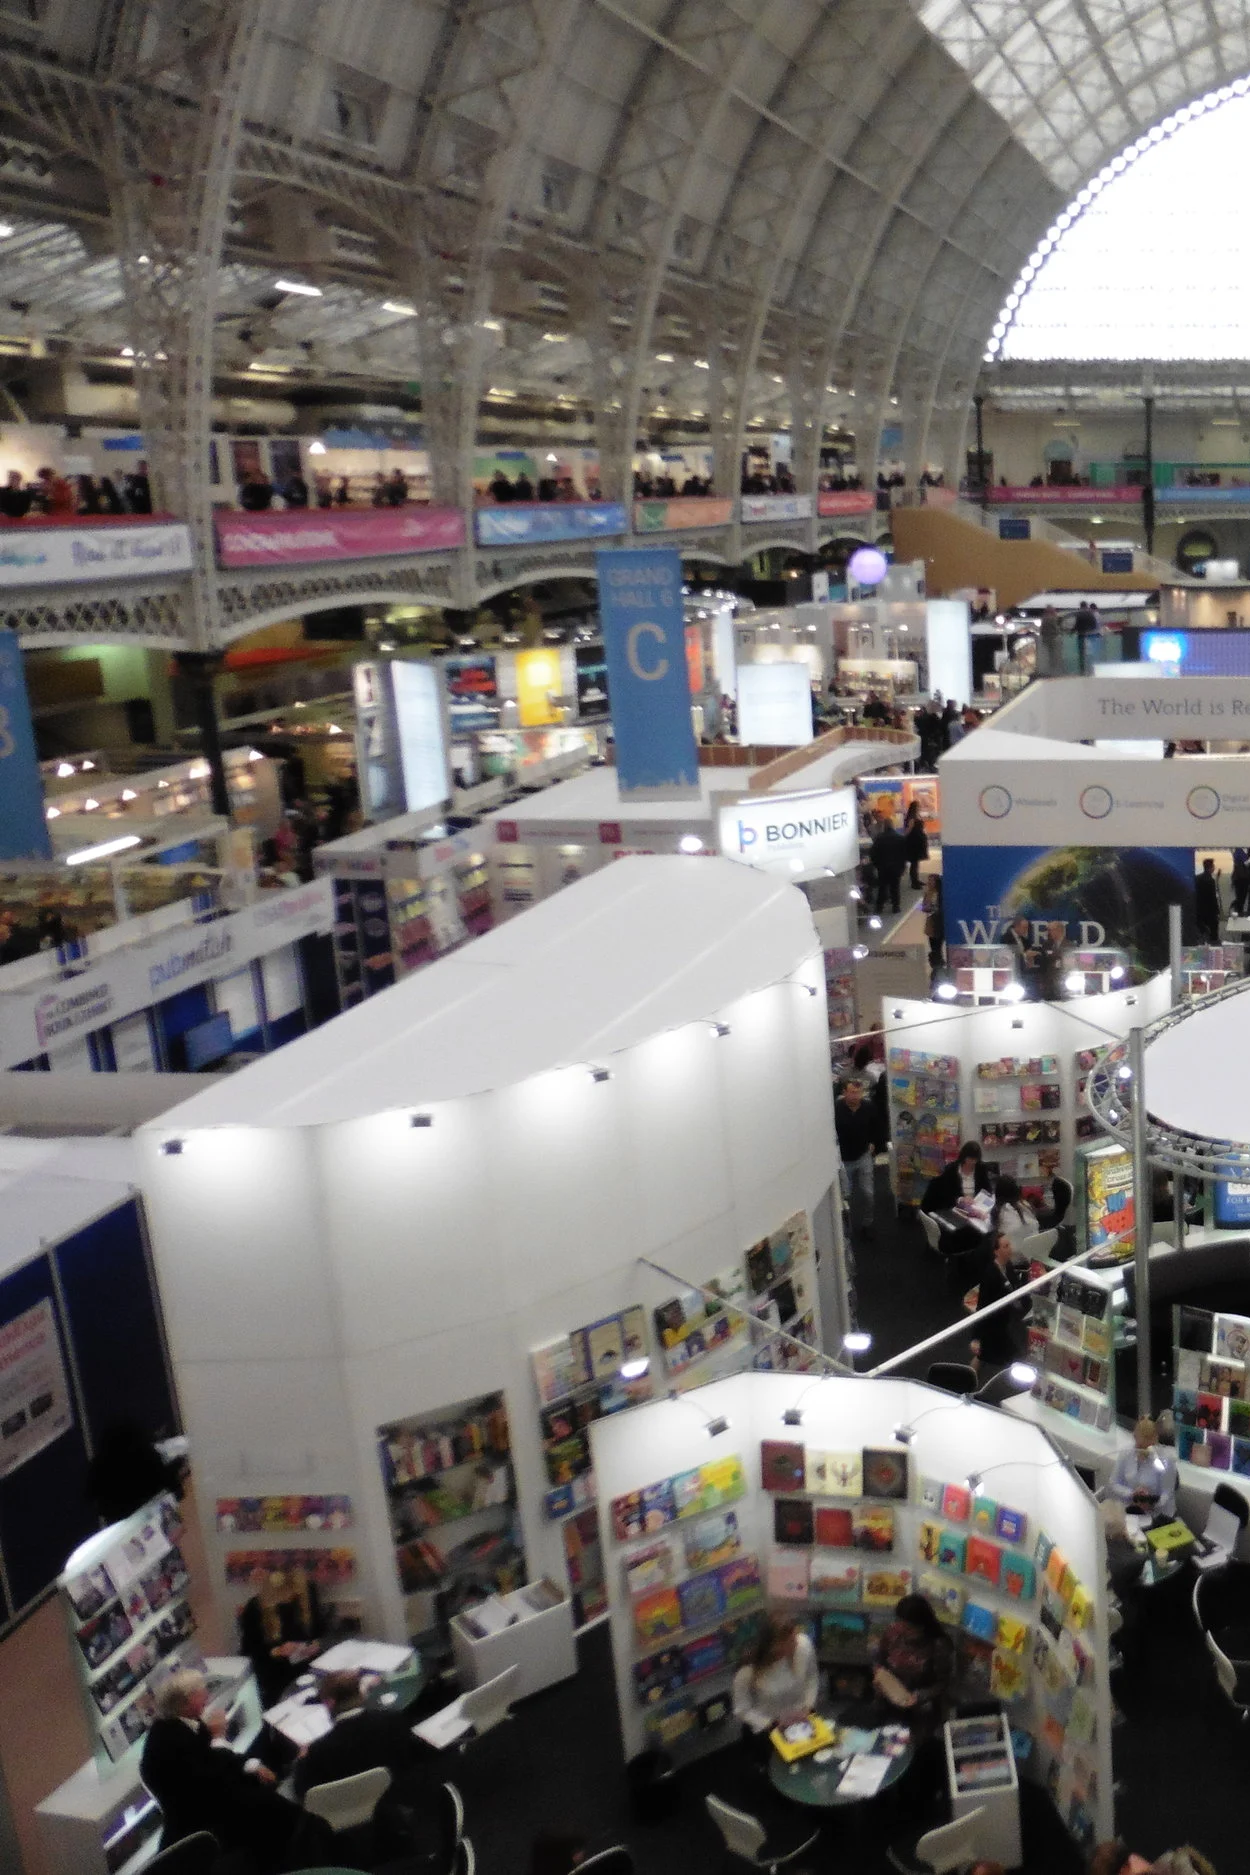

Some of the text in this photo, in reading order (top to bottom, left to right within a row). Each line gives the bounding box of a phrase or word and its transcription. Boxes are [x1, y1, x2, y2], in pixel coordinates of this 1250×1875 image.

[607, 567, 675, 587] GRAND
[611, 589, 657, 608] HALL
[627, 622, 669, 681] C
[1100, 699, 1135, 716] The
[1142, 698, 1202, 716] World
[1209, 699, 1226, 716] is
[766, 811, 850, 843] BONNIER
[957, 919, 1107, 948] WRD
[1226, 1196, 1244, 1205] FOR
